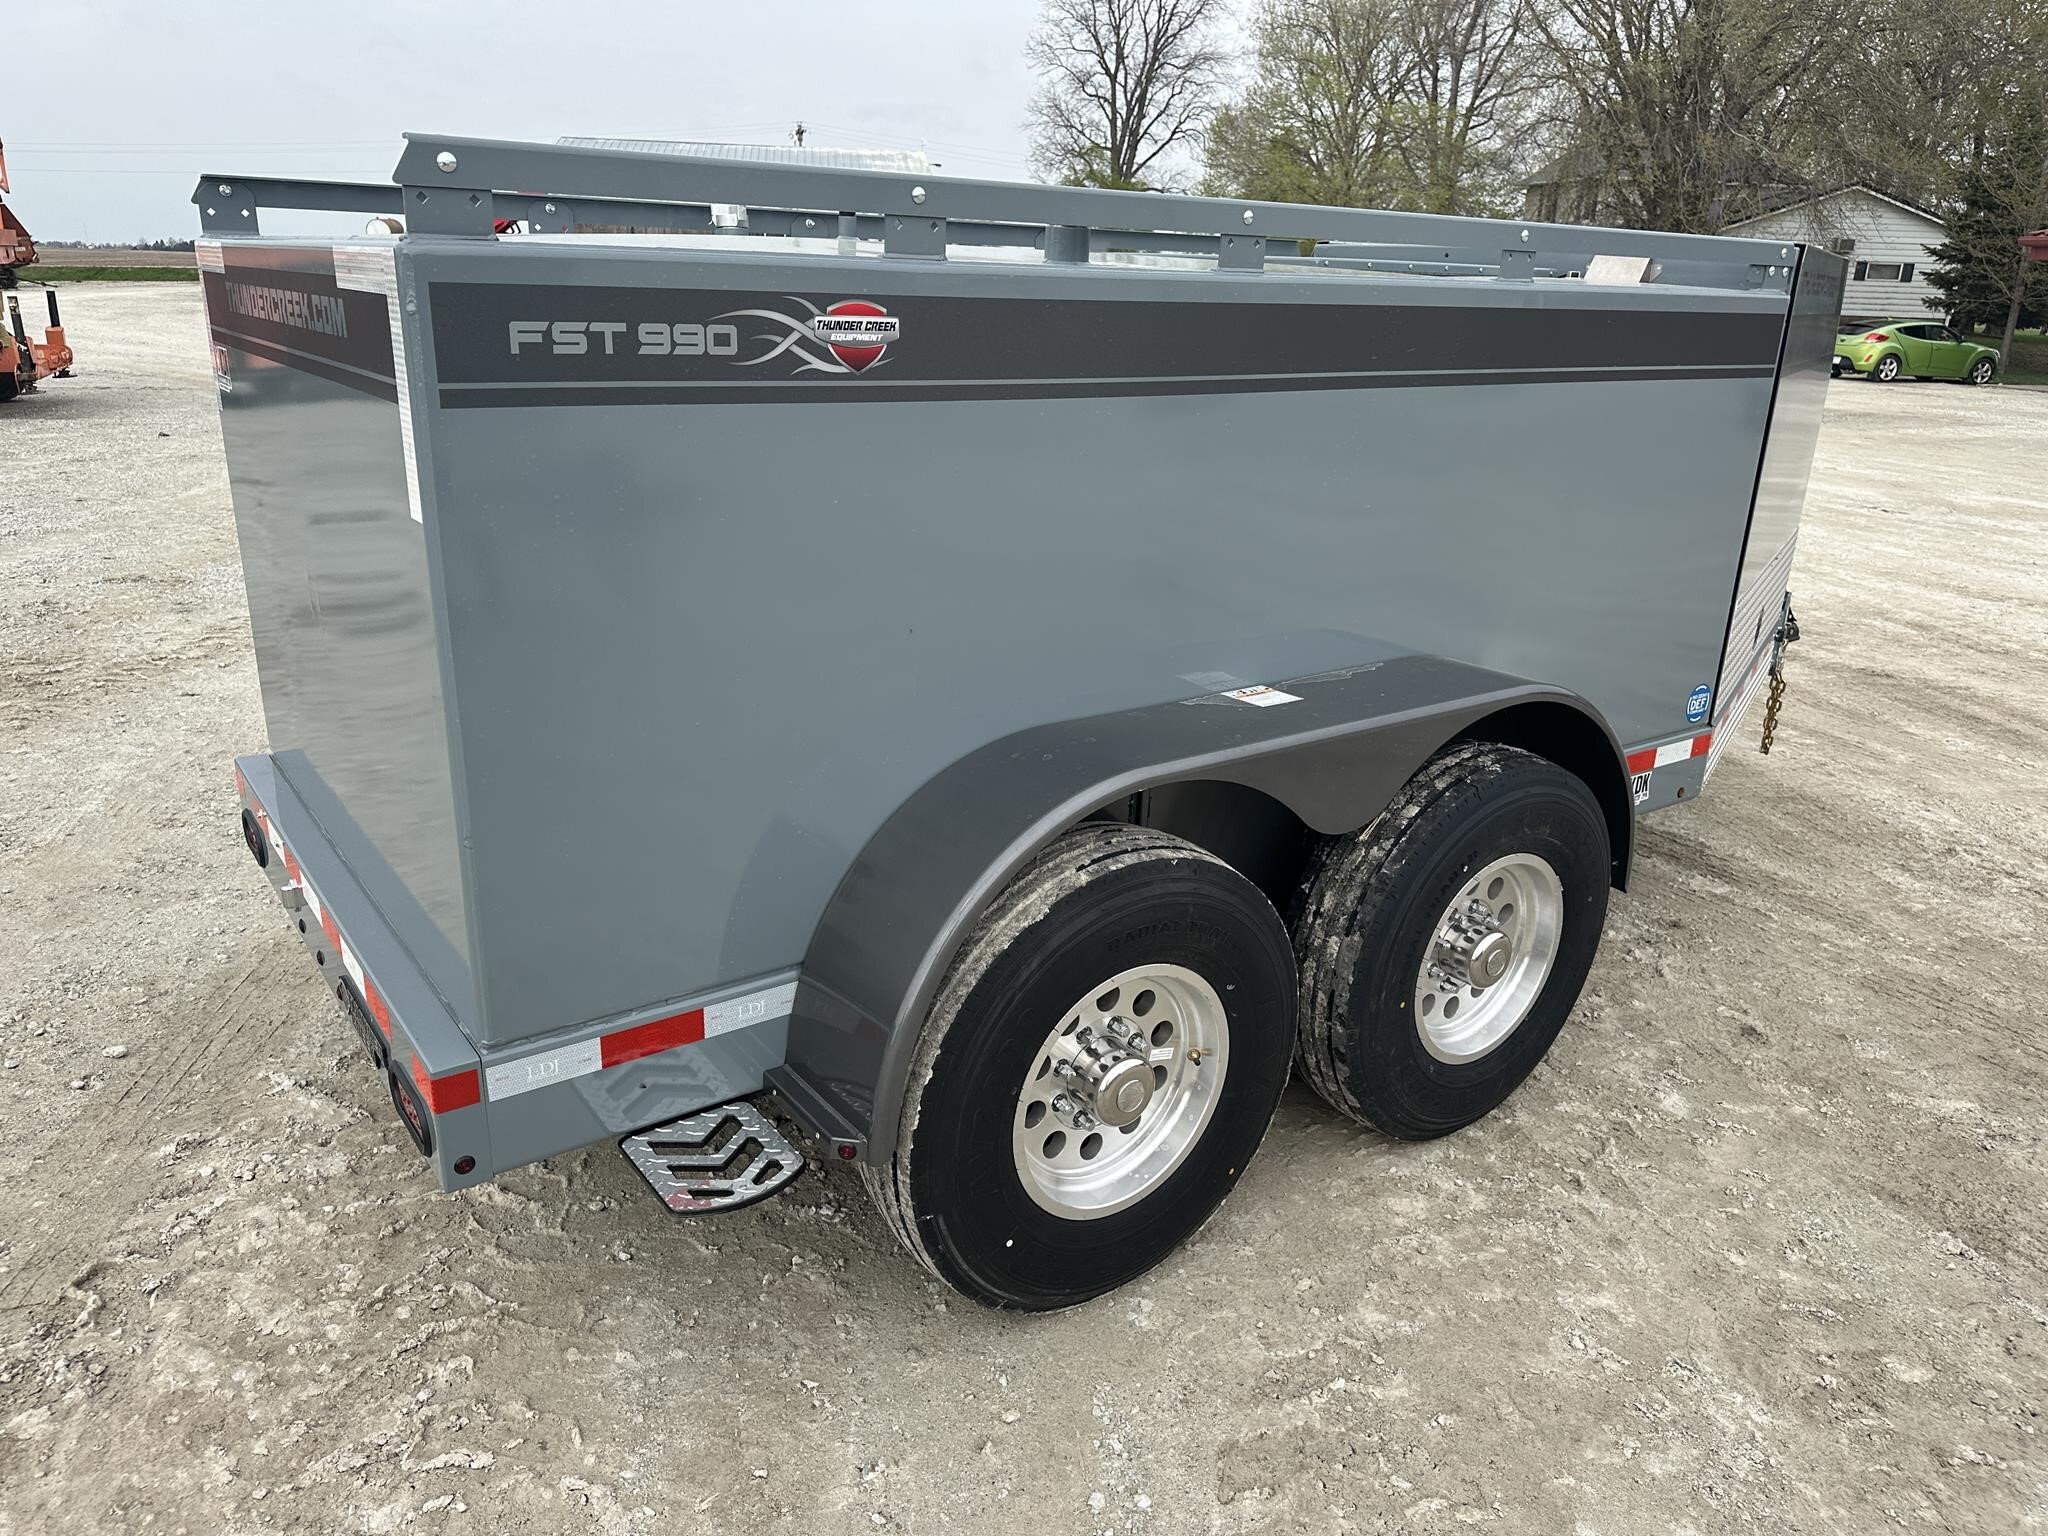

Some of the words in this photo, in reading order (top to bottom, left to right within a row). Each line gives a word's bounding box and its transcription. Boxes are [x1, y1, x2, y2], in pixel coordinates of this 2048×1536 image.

[224, 280, 348, 338] THUNDERCREEK.COM
[816, 320, 863, 331] THUNDER
[865, 321, 897, 332] CREEK
[508, 321, 627, 355] FST
[637, 323, 738, 355] 990
[830, 333, 884, 342] EQUIPMENT
[1690, 697, 1707, 711] DEF
